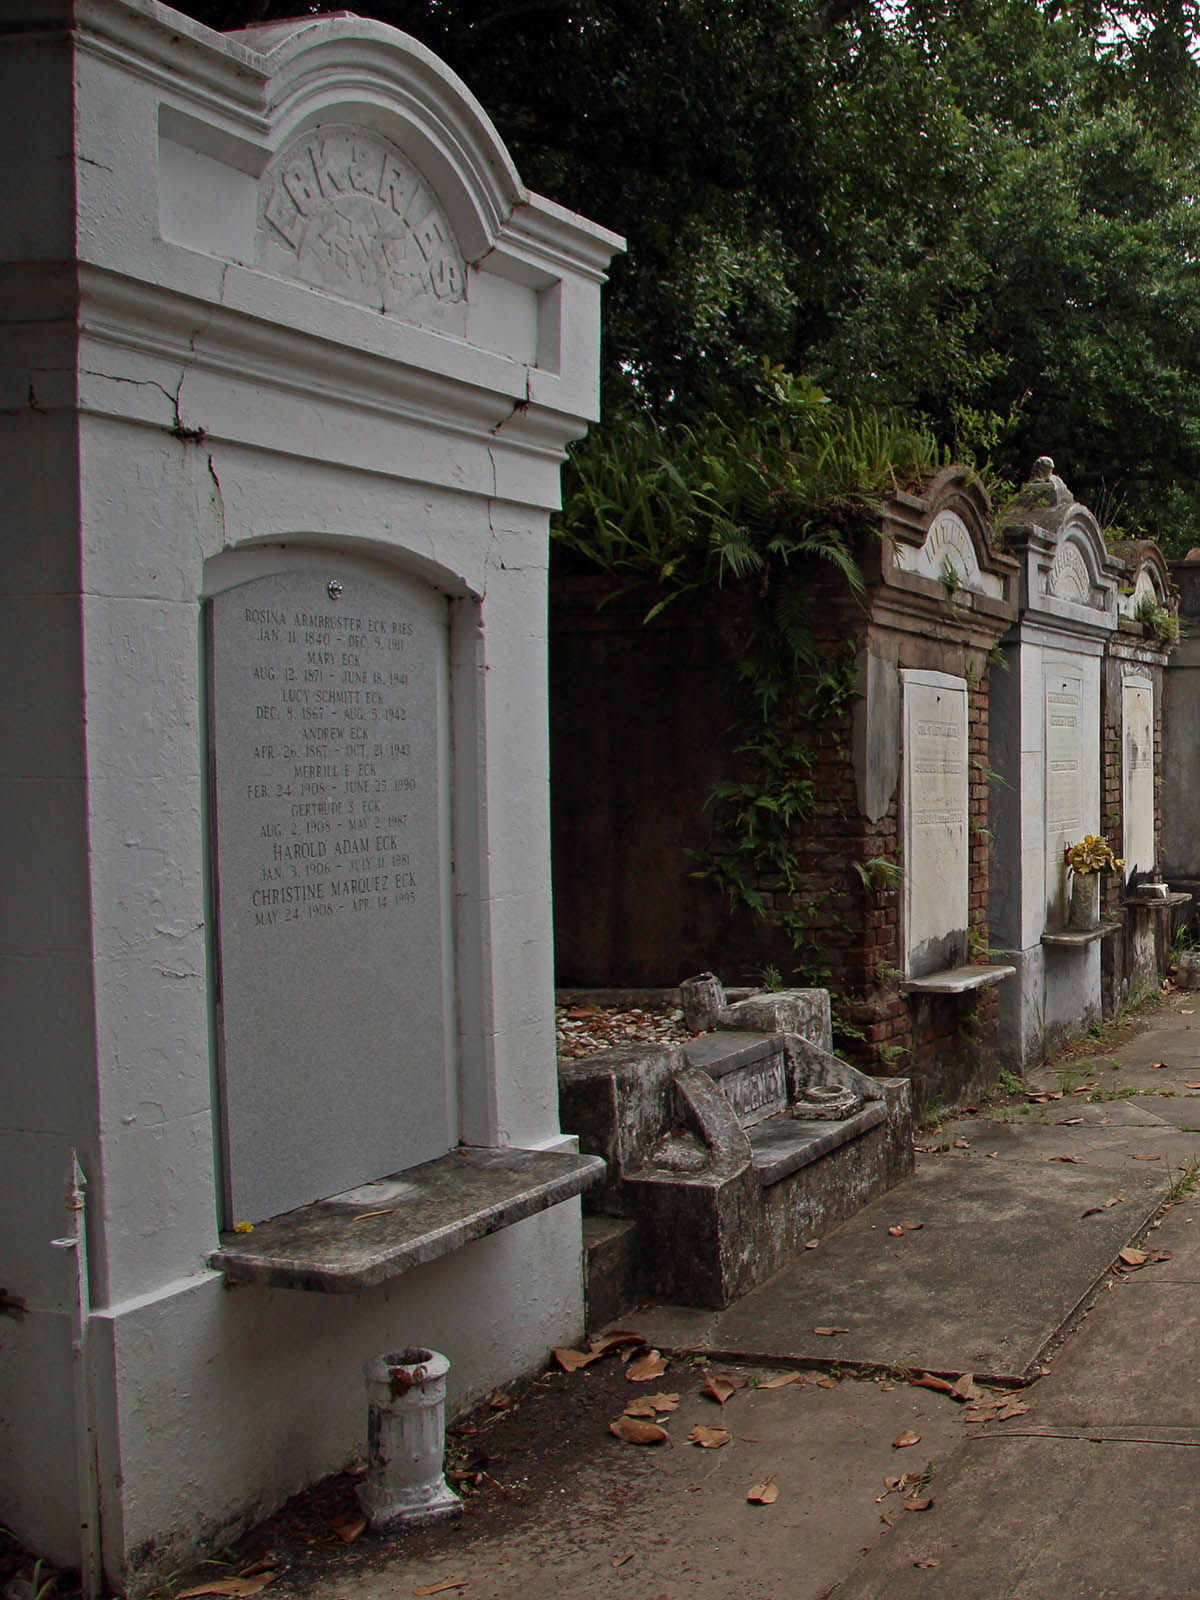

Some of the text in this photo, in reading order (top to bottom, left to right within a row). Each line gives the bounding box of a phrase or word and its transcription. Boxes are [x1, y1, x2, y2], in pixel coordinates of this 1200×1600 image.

[245, 609, 413, 636] ROSINA ARMBRUSTER ECK RIES
[305, 631, 330, 645] 1840
[307, 652, 360, 666] MARY ECK
[304, 669, 323, 683] 1871
[342, 671, 367, 684] JUNE
[282, 689, 384, 704] LUCY SCHMITT ECK
[302, 707, 324, 720] 1867
[385, 708, 406, 720] 1942
[304, 728, 368, 740] ANDREW ECK
[306, 744, 327, 758] 1867
[295, 764, 339, 778] MERRILL
[358, 764, 376, 777] ECK
[301, 782, 325, 796] 1908
[344, 780, 369, 794] JUNE
[394, 779, 416, 792] 1990
[291, 802, 343, 817] GERTRUDE
[362, 800, 380, 813] ECK
[306, 821, 331, 834] 1908
[349, 818, 367, 831] MAY
[274, 835, 398, 861] HAROLD ADAM ECK
[306, 863, 330, 876] 1906
[352, 857, 370, 871] JULY
[252, 872, 416, 907] CHRISTINE MARQUEZ ECK
[255, 911, 278, 926] MAY
[309, 903, 333, 918] 1908
